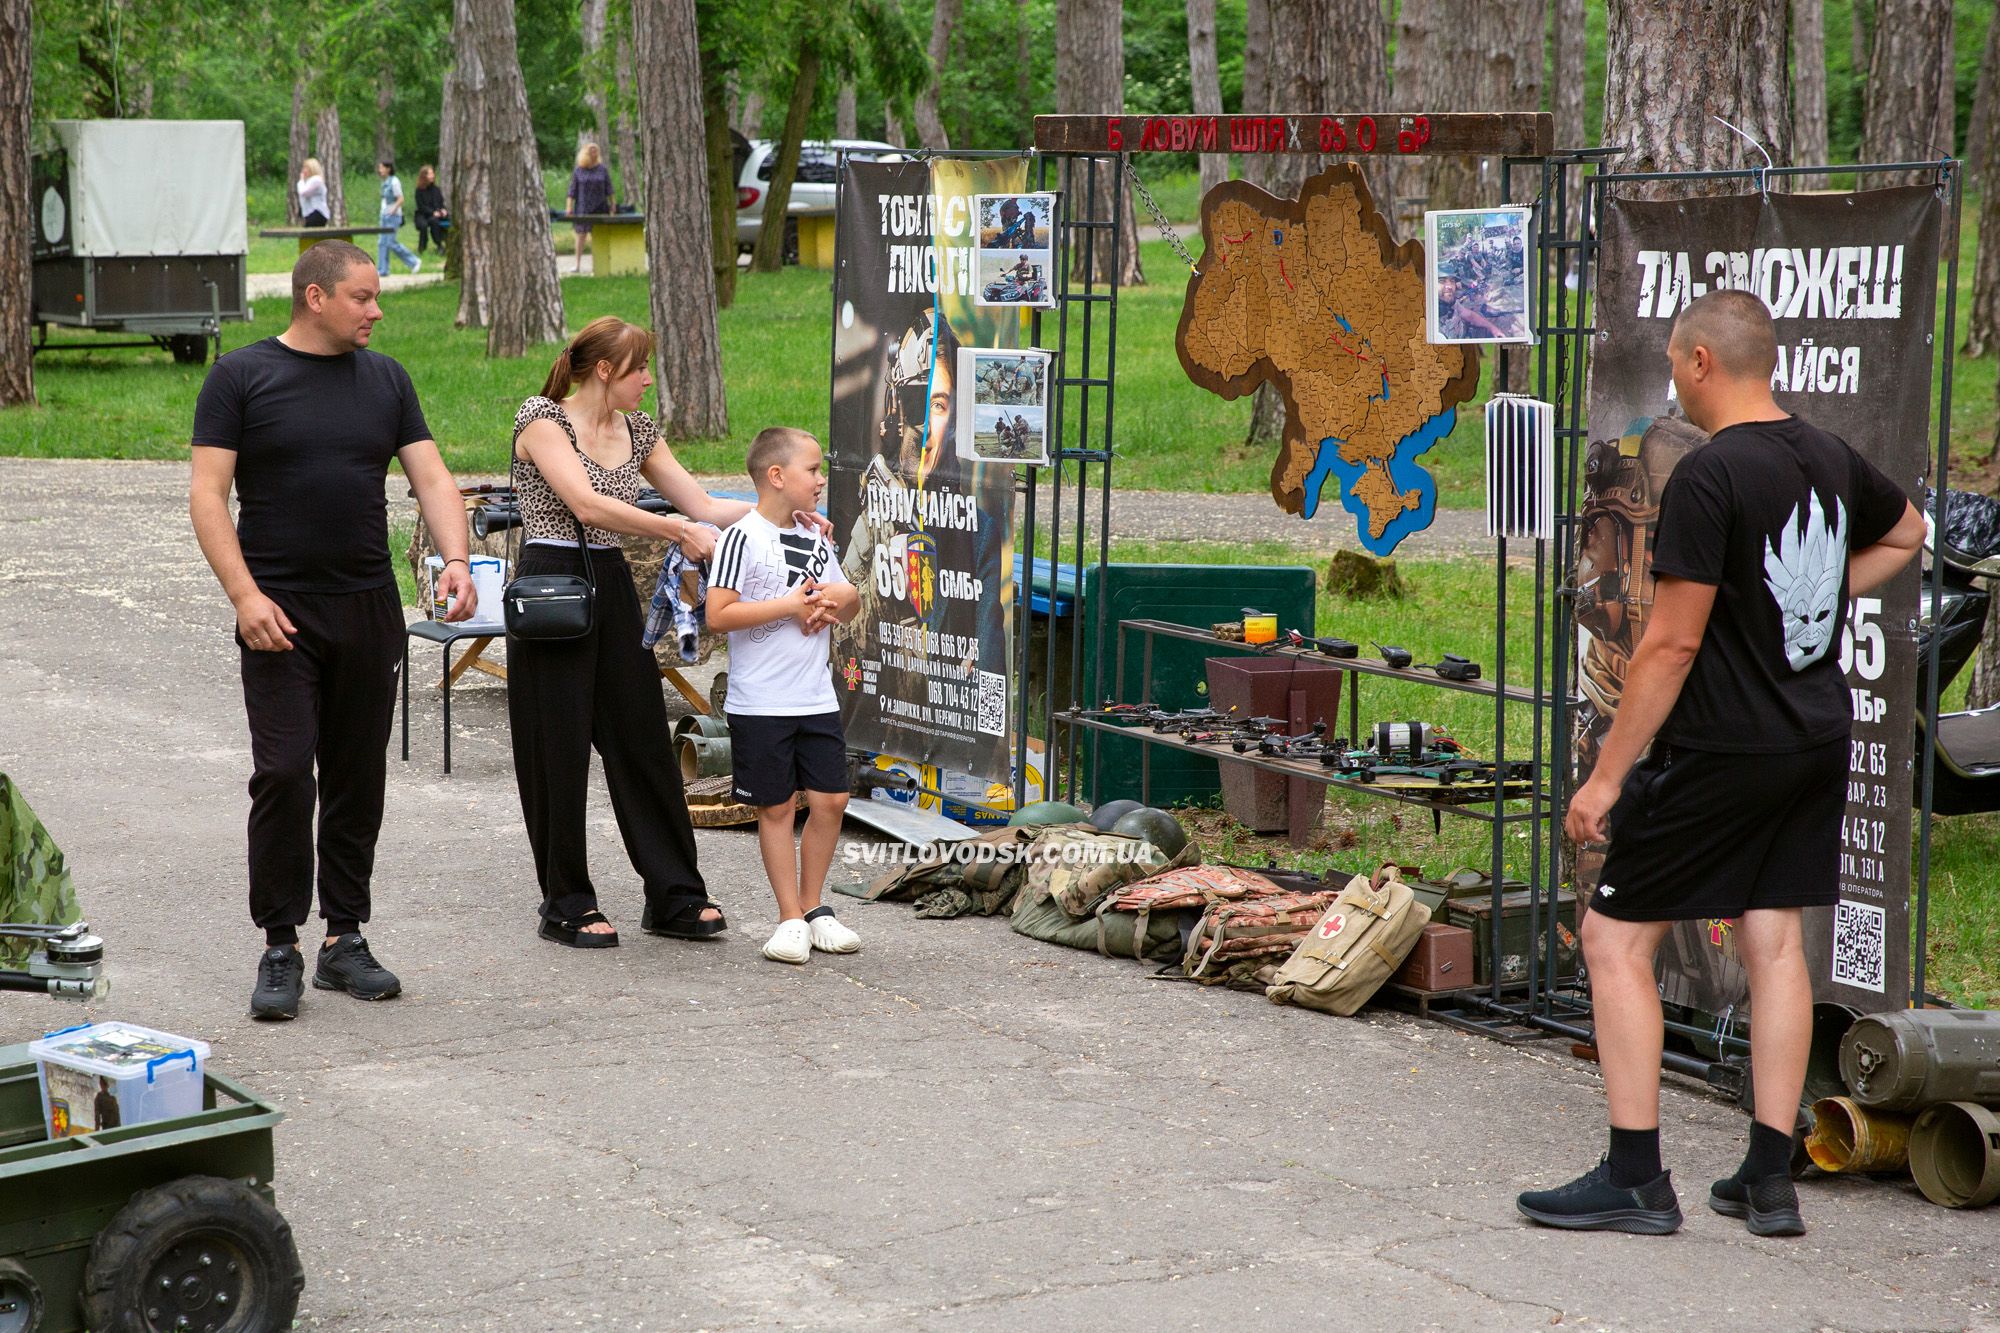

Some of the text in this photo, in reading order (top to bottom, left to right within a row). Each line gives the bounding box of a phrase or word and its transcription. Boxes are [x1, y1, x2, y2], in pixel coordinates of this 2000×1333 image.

[1320, 117, 1347, 153] 65
[867, 483, 978, 532] ДОЛУЧАЙСЯ
[875, 543, 907, 601] 65
[879, 621, 891, 645] 093
[892, 623, 904, 647] 397
[926, 630, 940, 655] 068
[941, 633, 955, 658] 666
[957, 636, 967, 660] 82
[969, 637, 979, 661] 63
[928, 680, 978, 712] 068 704 43 12
[1850, 740, 1886, 776] 82 63
[1847, 781, 1886, 808] ВАР, 23
[1852, 817, 1868, 851] 43
[1871, 821, 1885, 854] 12
[1861, 857, 1875, 881] 131
[1878, 861, 1885, 883] А
[1600, 884, 1615, 897] 4F
[1847, 884, 1884, 899] ОПЕРАТОРА
